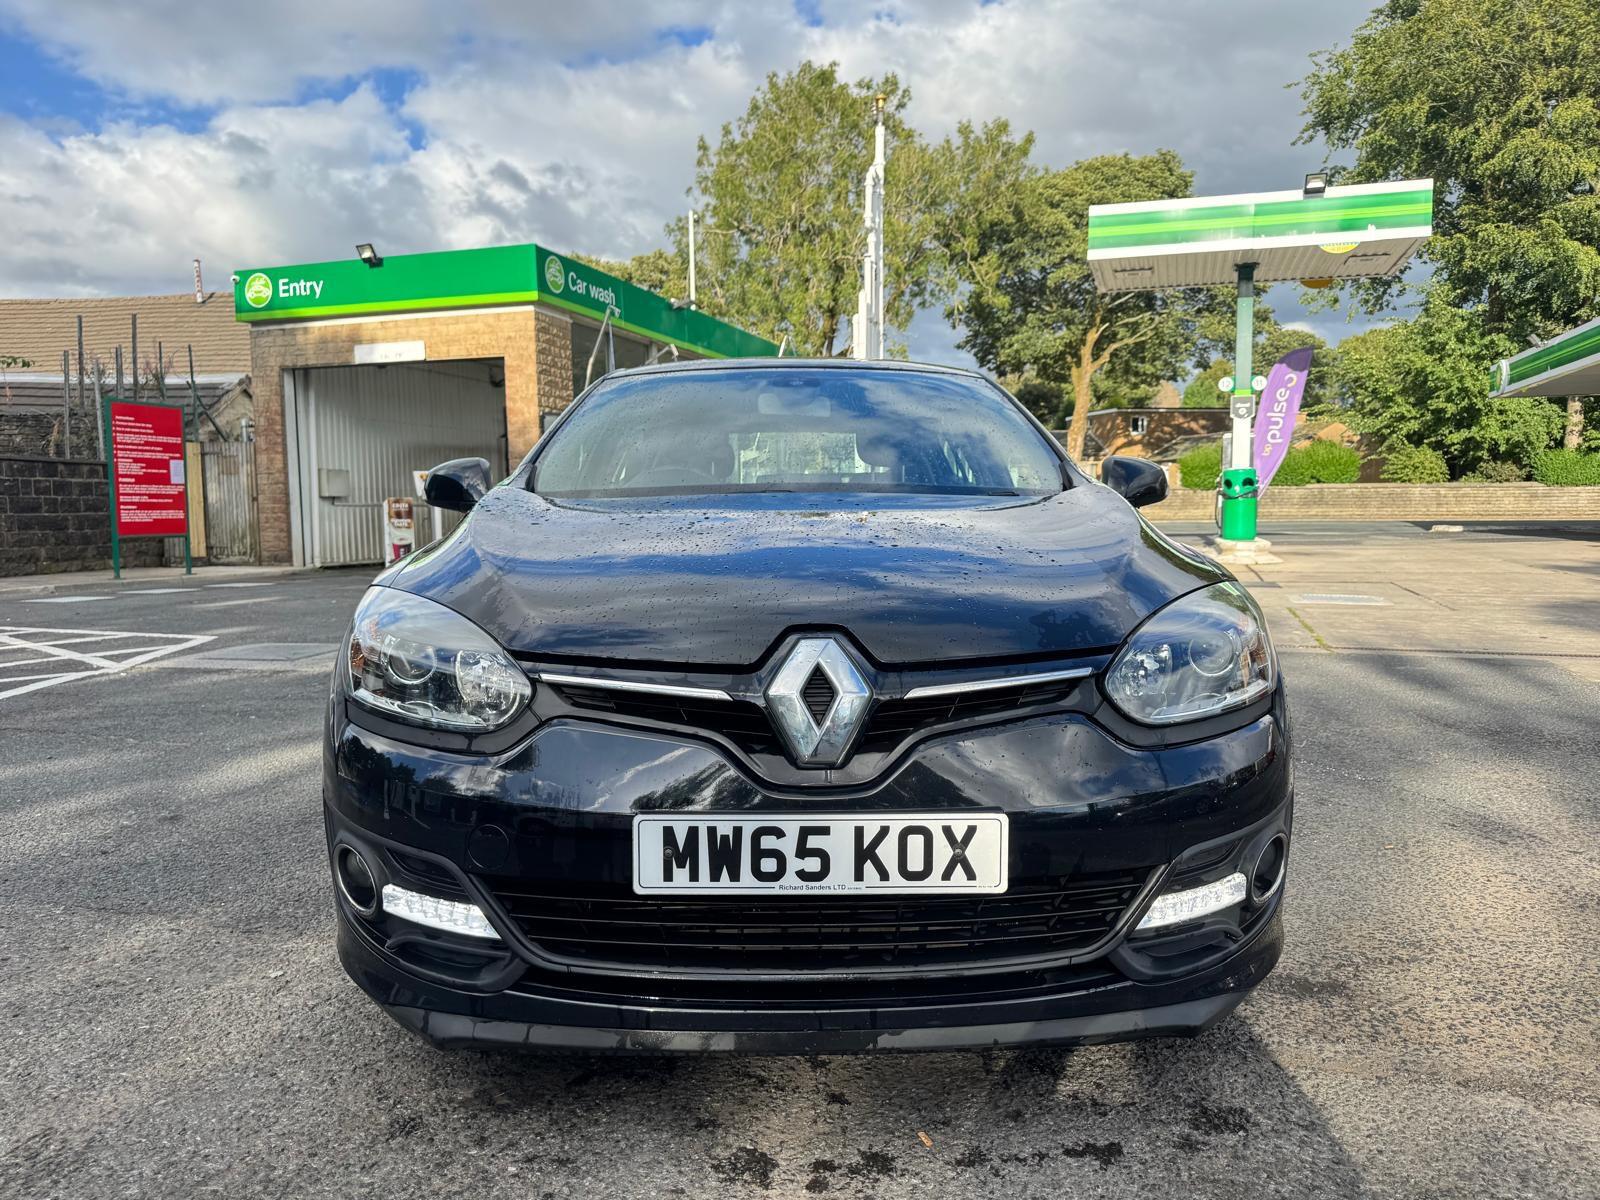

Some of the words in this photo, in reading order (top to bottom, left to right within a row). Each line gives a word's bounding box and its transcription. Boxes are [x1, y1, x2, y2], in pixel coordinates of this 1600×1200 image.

[278, 278, 324, 300] Entry
[568, 271, 587, 295] Car
[589, 282, 616, 306] wash
[1266, 388, 1290, 443] pulse
[662, 825, 831, 883] MW65
[853, 824, 978, 882] KOX
